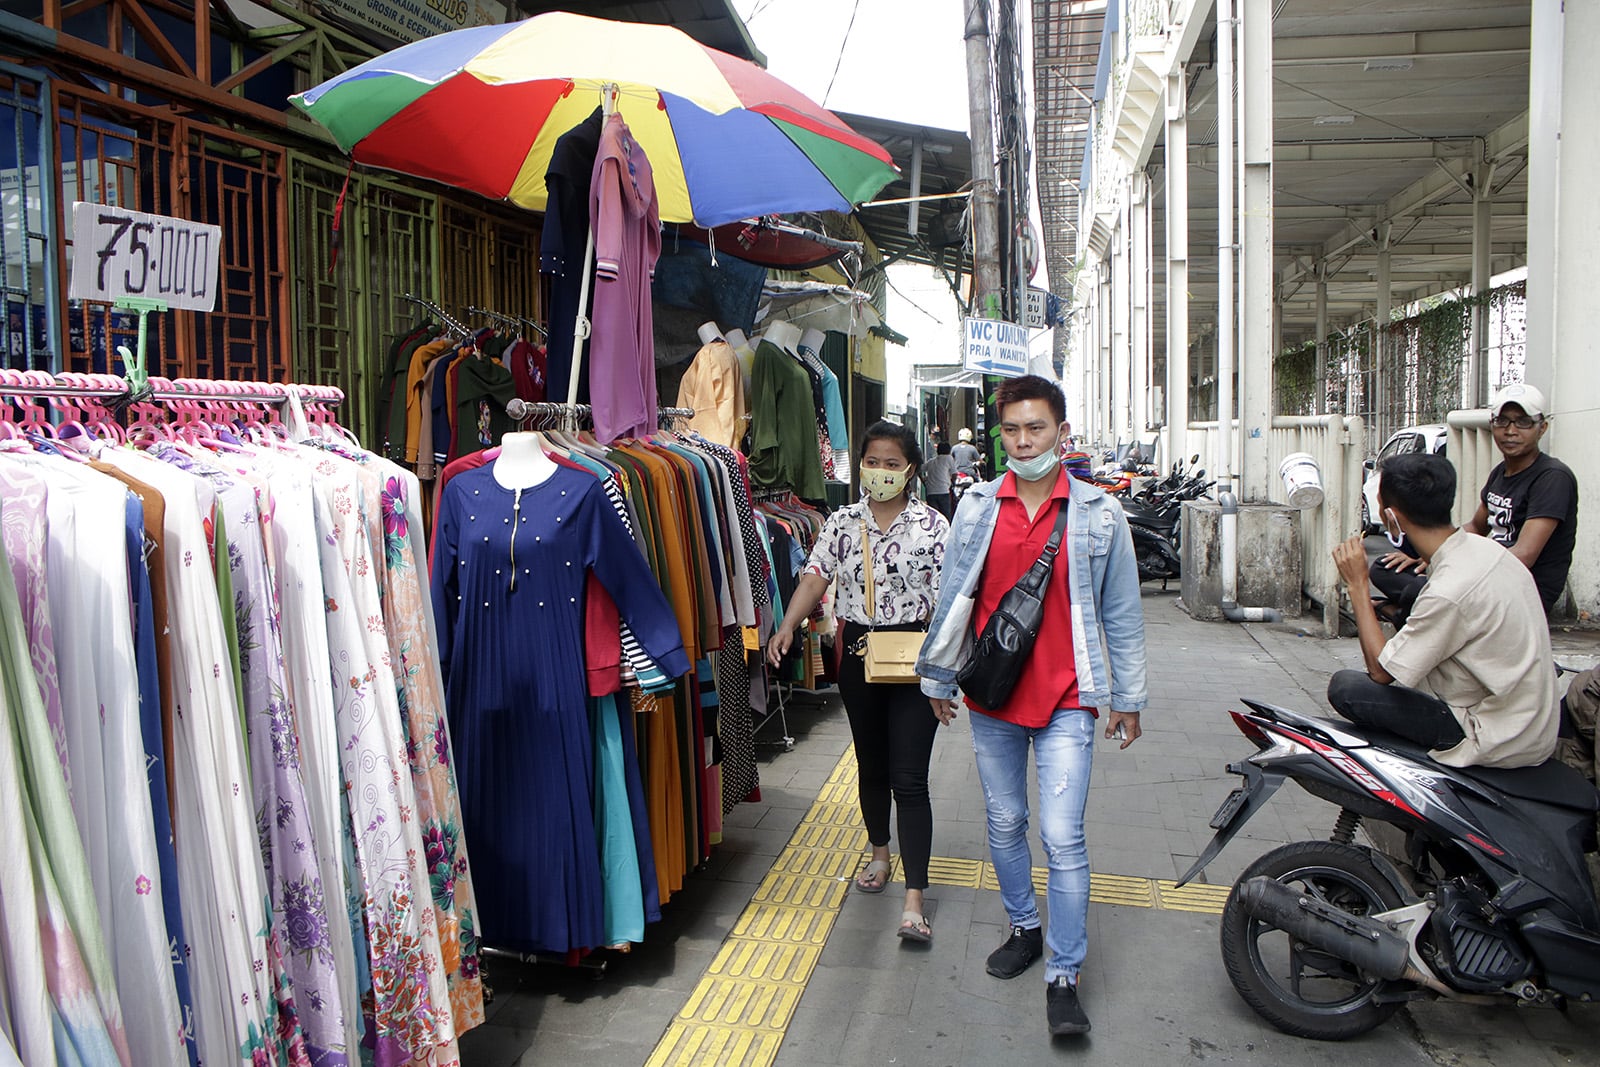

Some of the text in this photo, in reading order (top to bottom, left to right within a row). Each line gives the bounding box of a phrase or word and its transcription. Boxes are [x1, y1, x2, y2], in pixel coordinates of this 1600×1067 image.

[367, 0, 398, 21] GROSIR
[398, 15, 405, 26] &
[421, 10, 457, 32] ANAK-AN
[970, 321, 1028, 347] WC UMUM
[969, 344, 991, 357] PRIA
[999, 347, 1027, 363] WANITA
